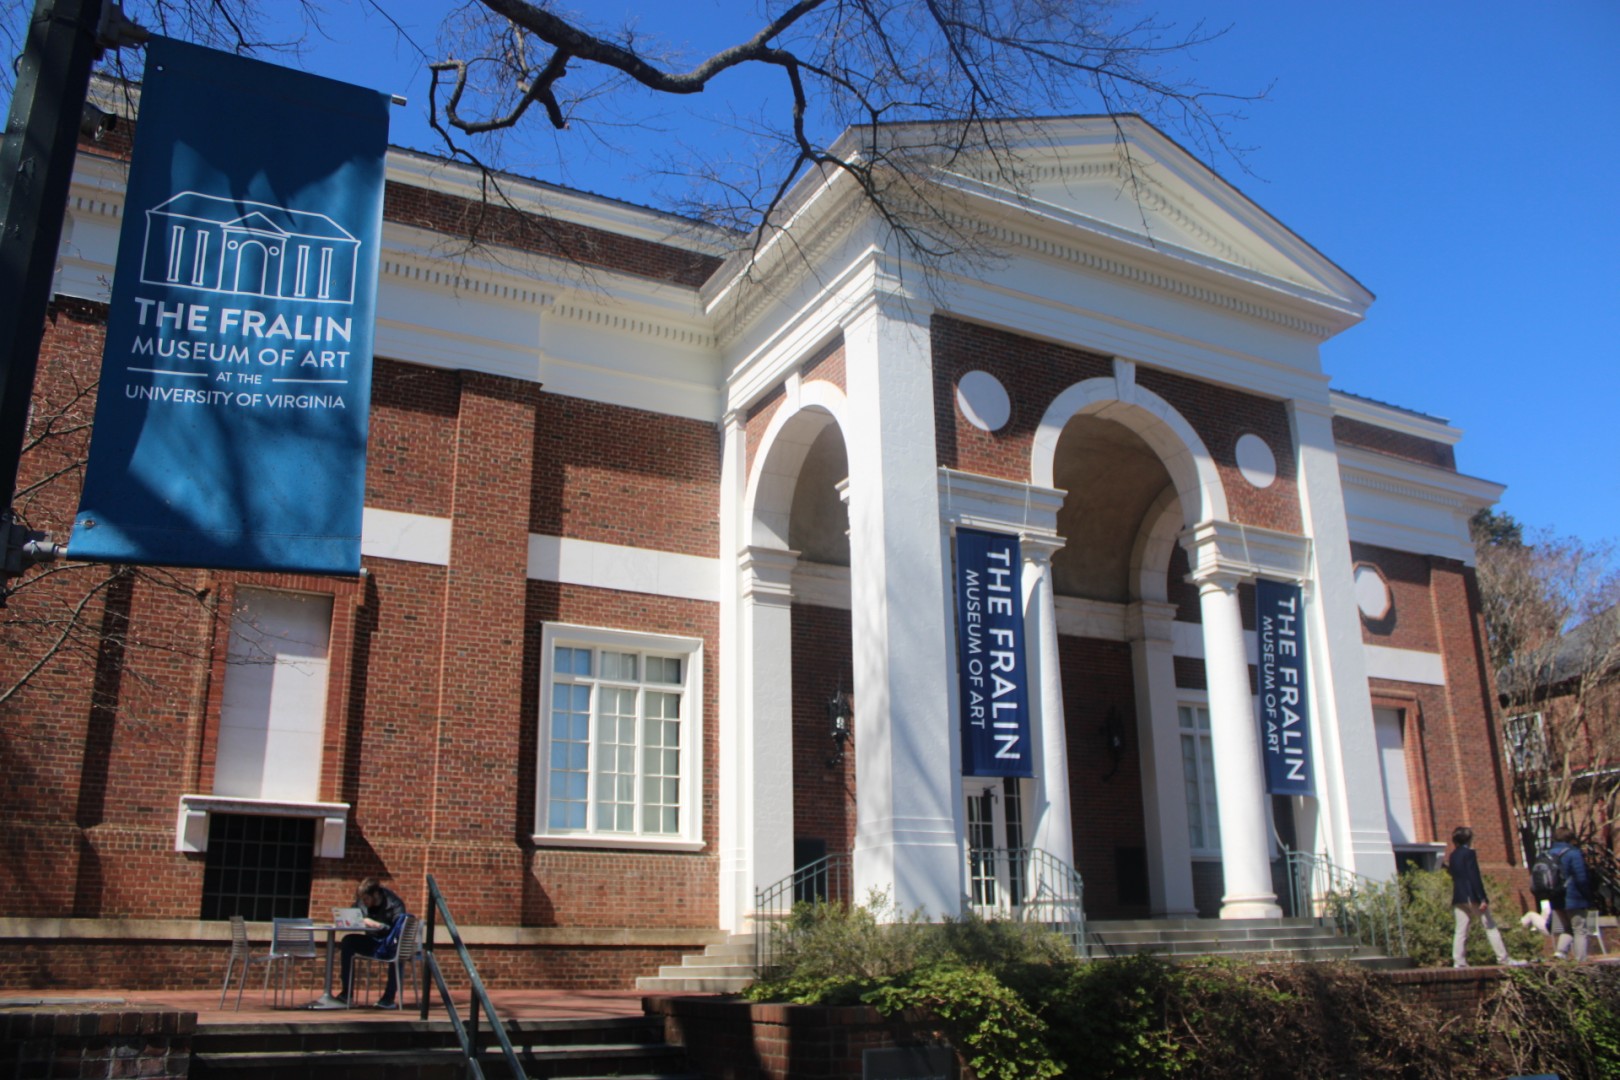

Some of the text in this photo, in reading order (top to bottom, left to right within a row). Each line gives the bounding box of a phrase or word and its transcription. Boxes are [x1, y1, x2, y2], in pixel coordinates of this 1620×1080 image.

[131, 336, 350, 368] MUSEUM OF ART
[135, 297, 352, 342] THE FRALIN
[125, 384, 345, 408] UNIVERSITY OF VIRGINIA
[216, 372, 262, 384] AT THE
[966, 569, 985, 729] MUSEUM OF ART
[987, 548, 1020, 760] THE FRALIN
[1262, 615, 1279, 754] MUSEUM OF ART
[1278, 597, 1305, 781] THE FRALIN
